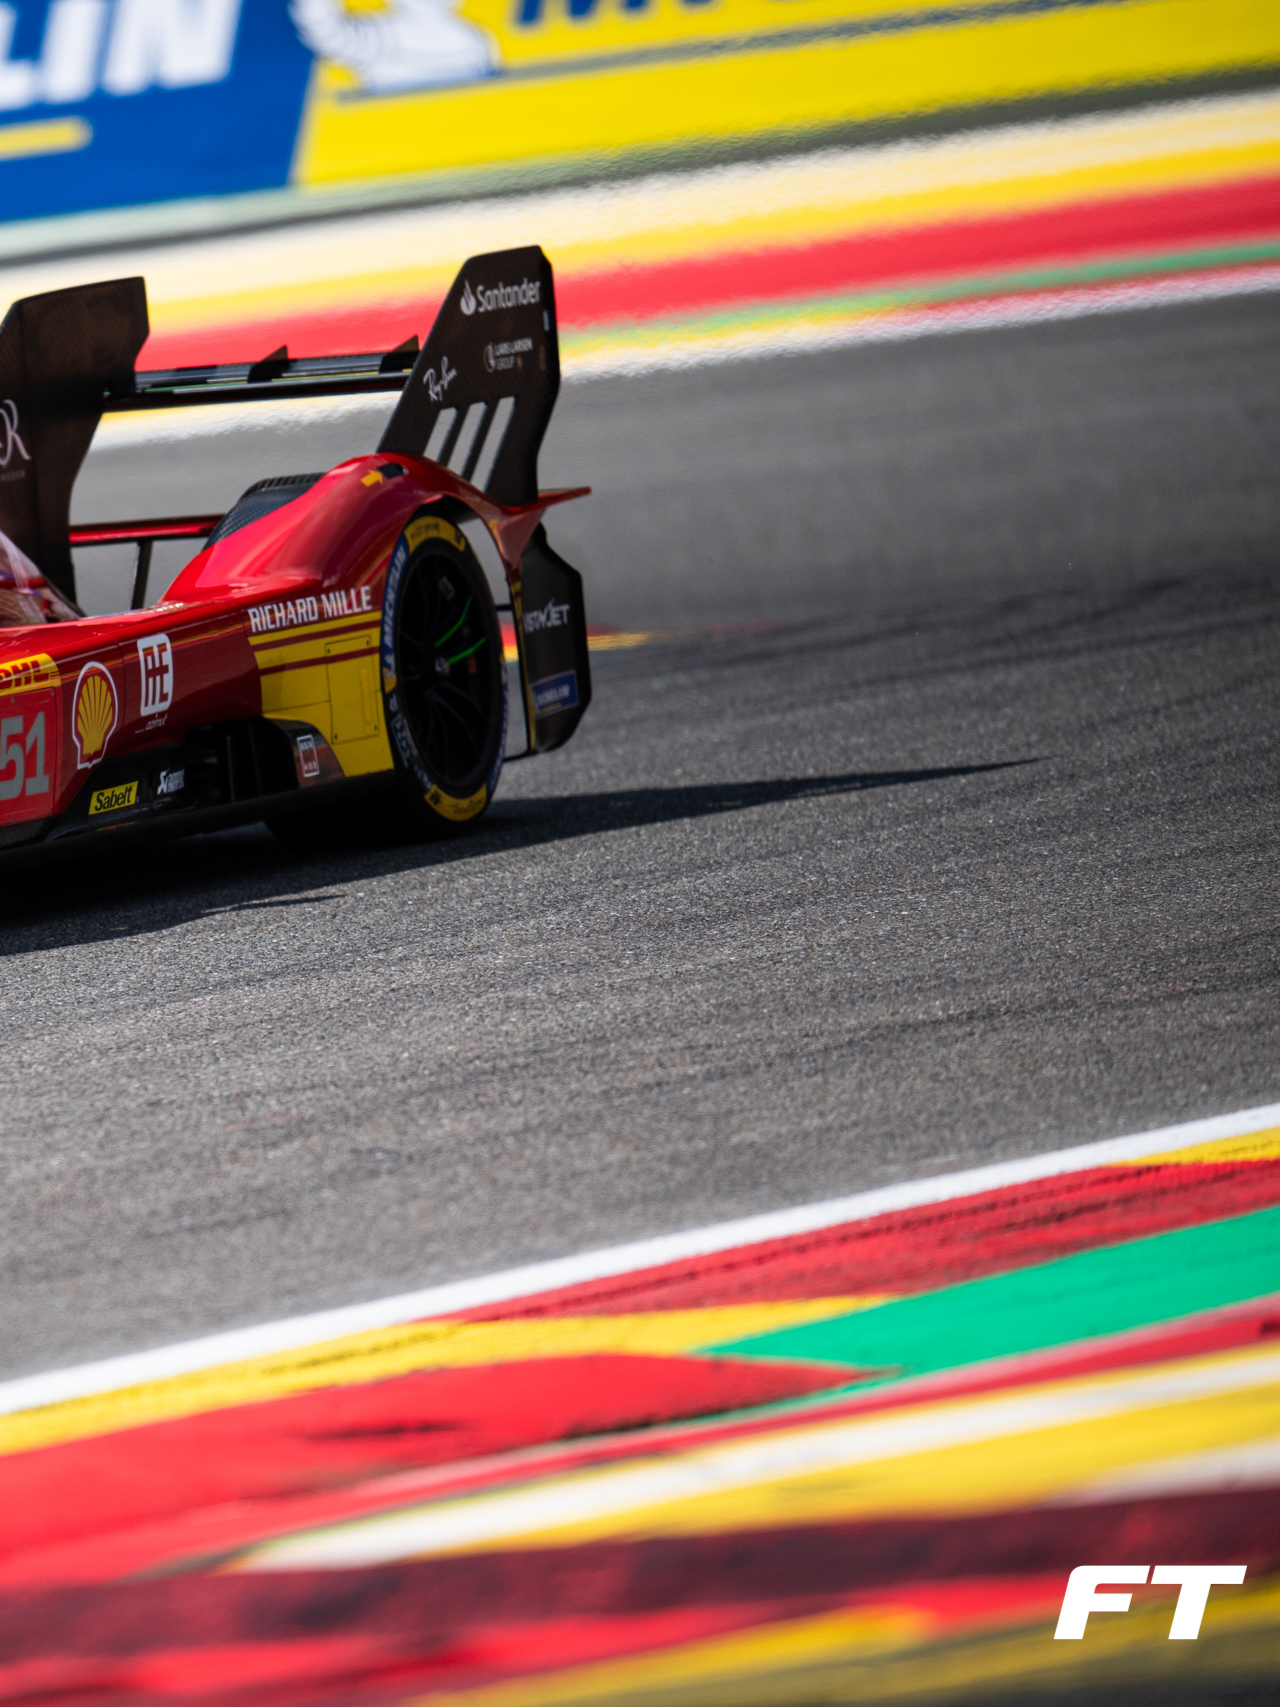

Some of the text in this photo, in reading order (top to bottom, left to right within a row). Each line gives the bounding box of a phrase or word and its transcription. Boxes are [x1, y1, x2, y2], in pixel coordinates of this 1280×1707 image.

[477, 277, 541, 313] Santander
[247, 585, 373, 633] RICHARD MILLE
[94, 785, 133, 812] Sabelt
